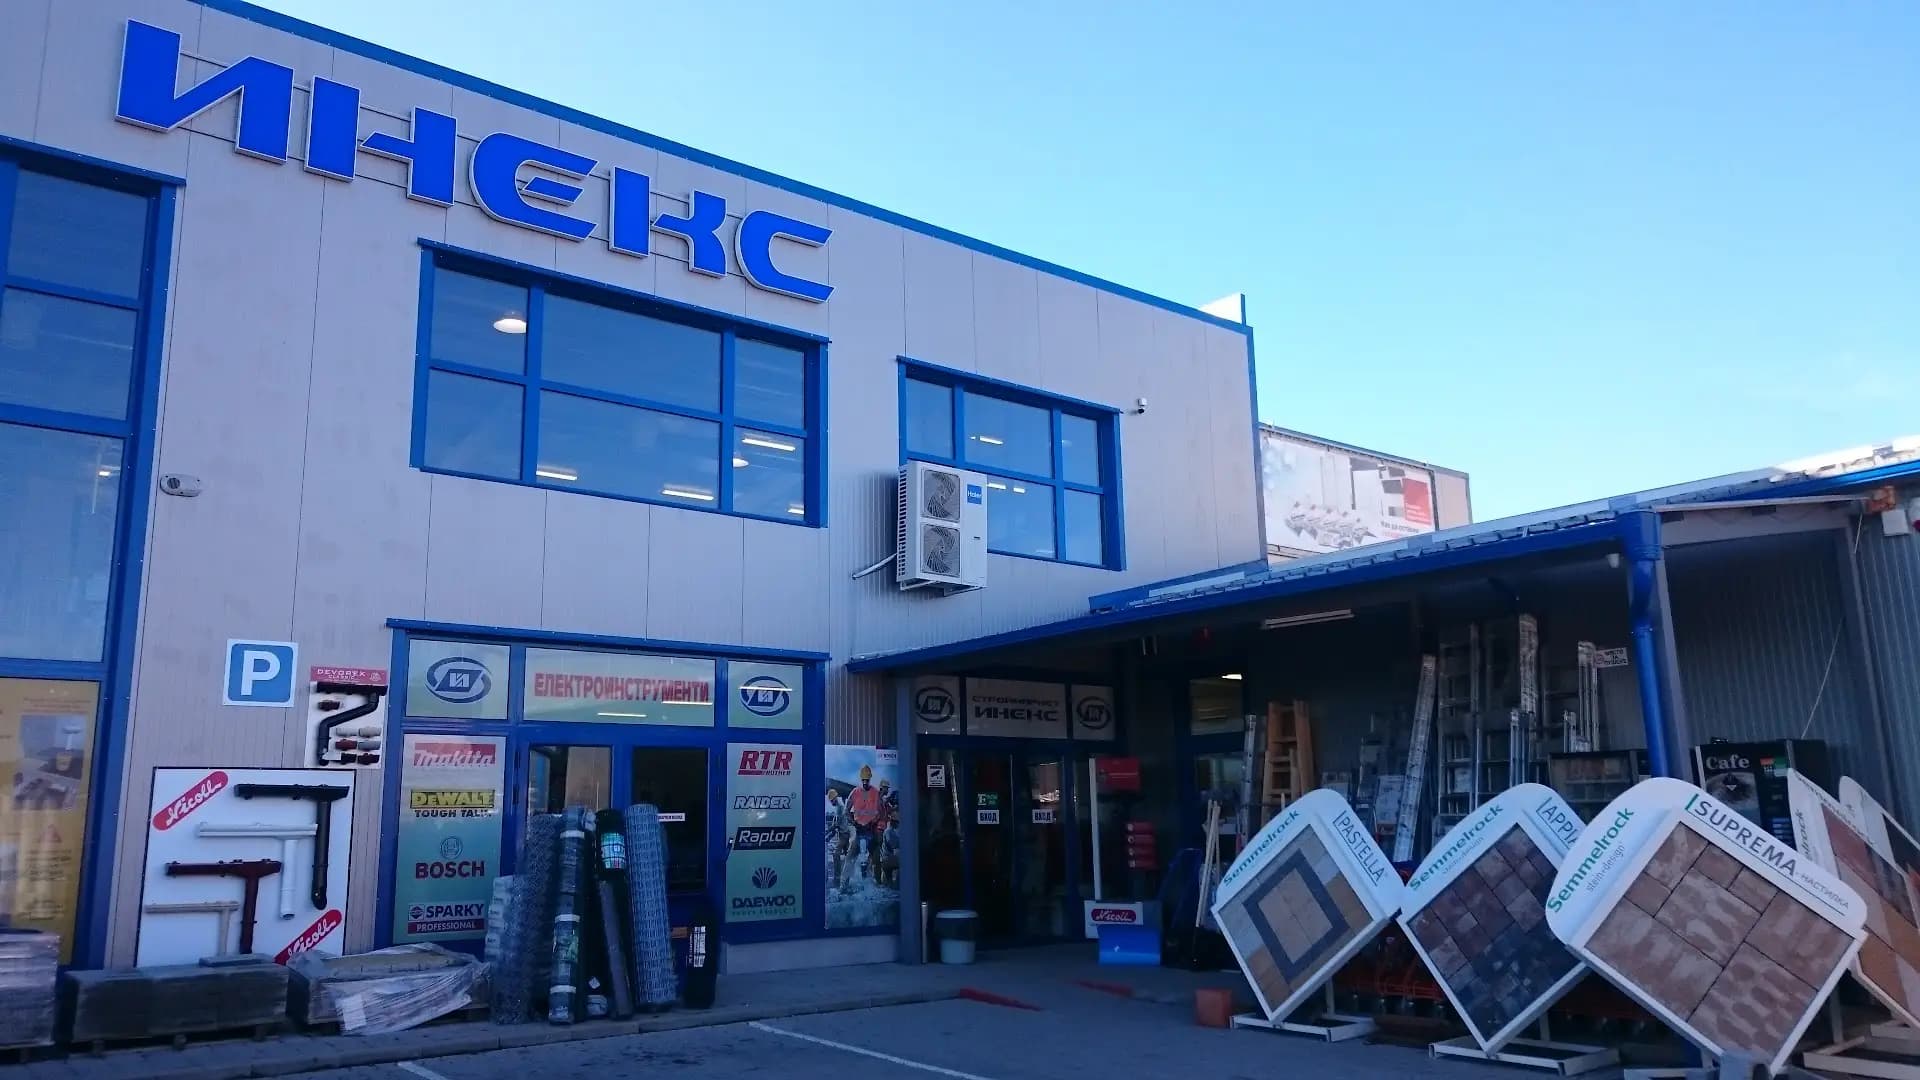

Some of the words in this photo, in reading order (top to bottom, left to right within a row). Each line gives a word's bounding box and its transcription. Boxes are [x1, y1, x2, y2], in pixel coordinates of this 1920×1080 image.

[115, 17, 834, 304] ИНЕКС
[240, 650, 280, 696] P
[534, 673, 709, 702] ЕЛЕКТРОИНСТРУМЕНТИ
[740, 751, 792, 770] RTR
[1705, 753, 1751, 770] Cafe
[734, 796, 792, 809] RAIDER
[415, 809, 456, 818] TOUGH
[739, 830, 791, 846] Raptor
[1223, 808, 1301, 887] Semmelrock
[1409, 803, 1505, 891] Semmelrock
[1694, 800, 1797, 876] SUPREMA
[1338, 818, 1386, 882] PASTELLA
[1548, 806, 1634, 913] Semmelrock
[415, 861, 485, 879] BOSCH
[426, 904, 484, 918] SPARKY
[732, 895, 796, 909] DAEWOO
[416, 921, 476, 932] PROFESSIONAL
